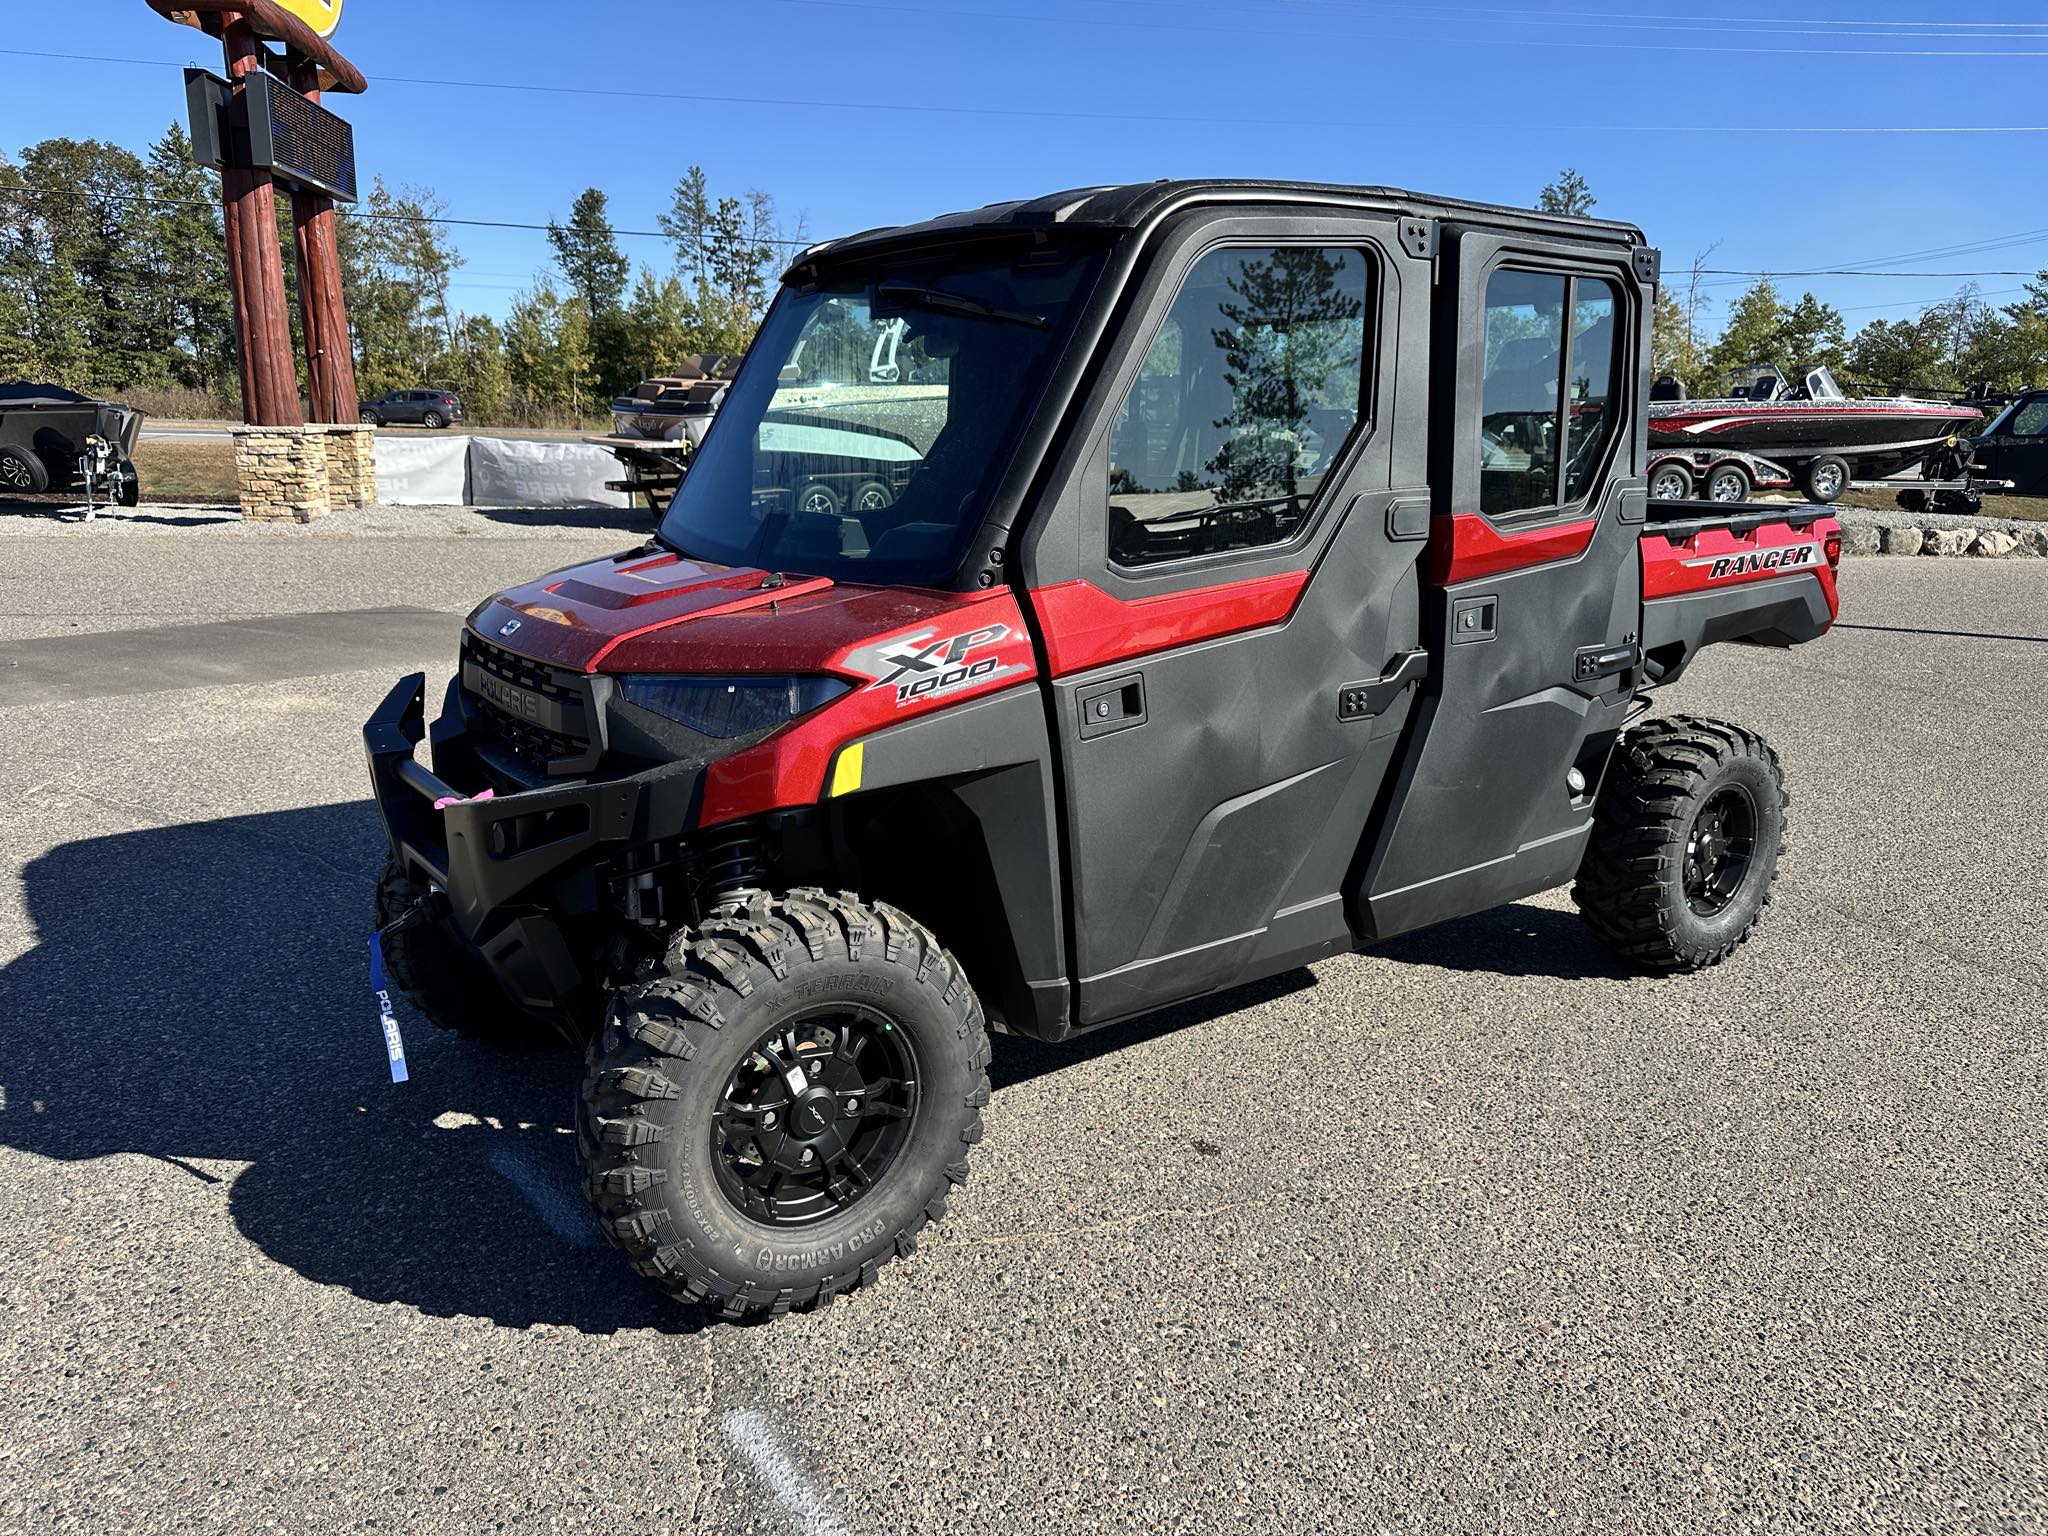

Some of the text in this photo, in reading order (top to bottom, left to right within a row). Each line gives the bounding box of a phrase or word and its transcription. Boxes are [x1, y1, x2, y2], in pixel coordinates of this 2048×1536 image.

[1708, 545, 1813, 579] RANGER
[861, 623, 1012, 693] XP
[896, 657, 998, 703] 1000
[480, 672, 537, 717] POLARIS
[896, 697, 921, 708] DUAL
[923, 681, 972, 700] OVERHEAD
[765, 973, 895, 1016] X-TERRAIN
[376, 989, 402, 1061] POLARIS
[775, 1218, 886, 1270] PRO ARMOR
